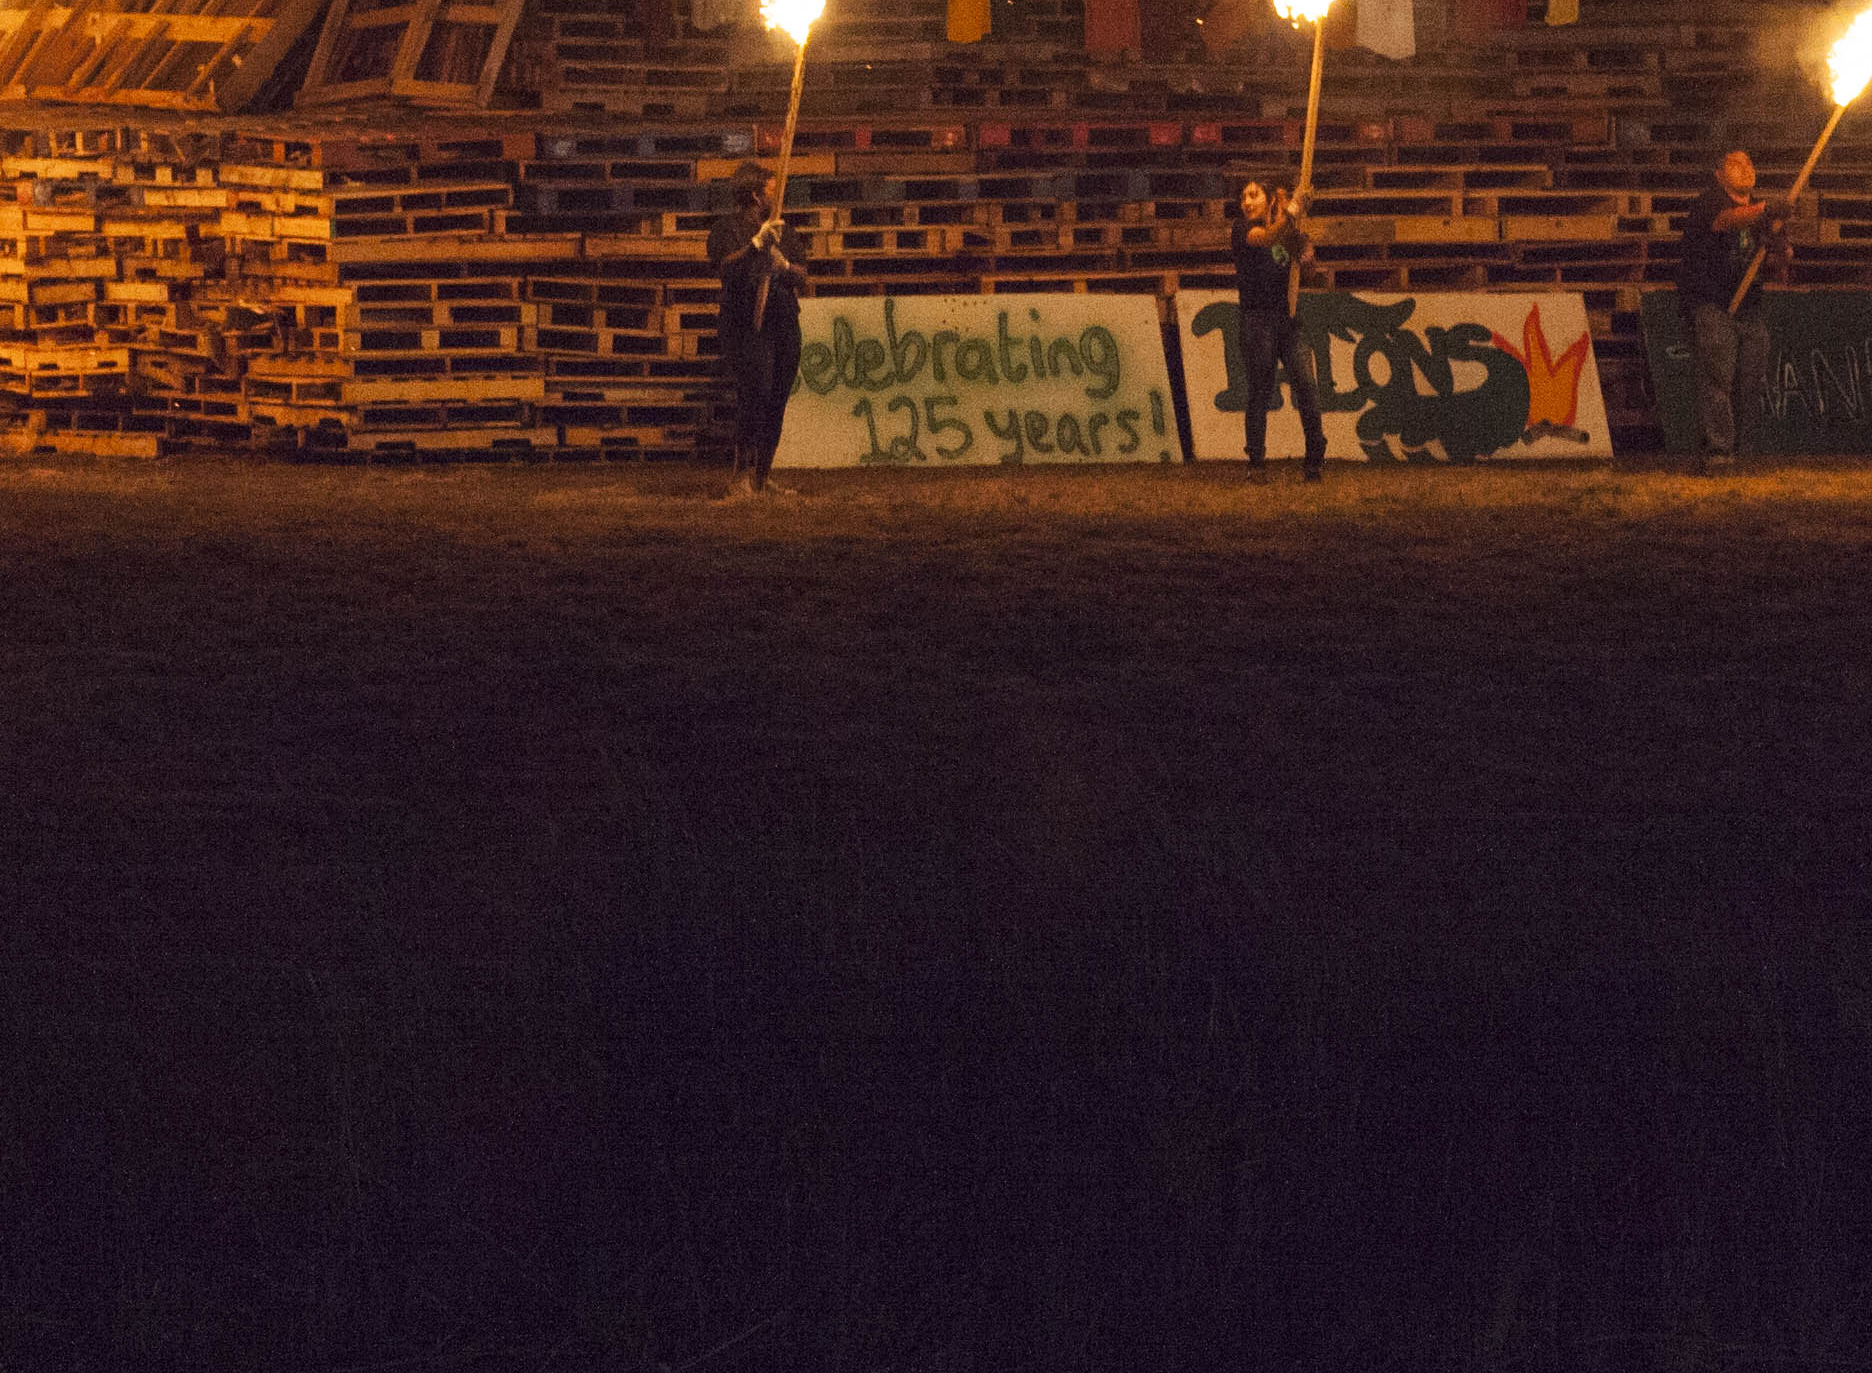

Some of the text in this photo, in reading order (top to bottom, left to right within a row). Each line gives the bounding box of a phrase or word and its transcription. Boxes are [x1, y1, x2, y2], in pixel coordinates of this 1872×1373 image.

[792, 298, 1122, 400] elebrating
[1192, 292, 1530, 440] TLONS
[852, 388, 1172, 465] 125 years!
